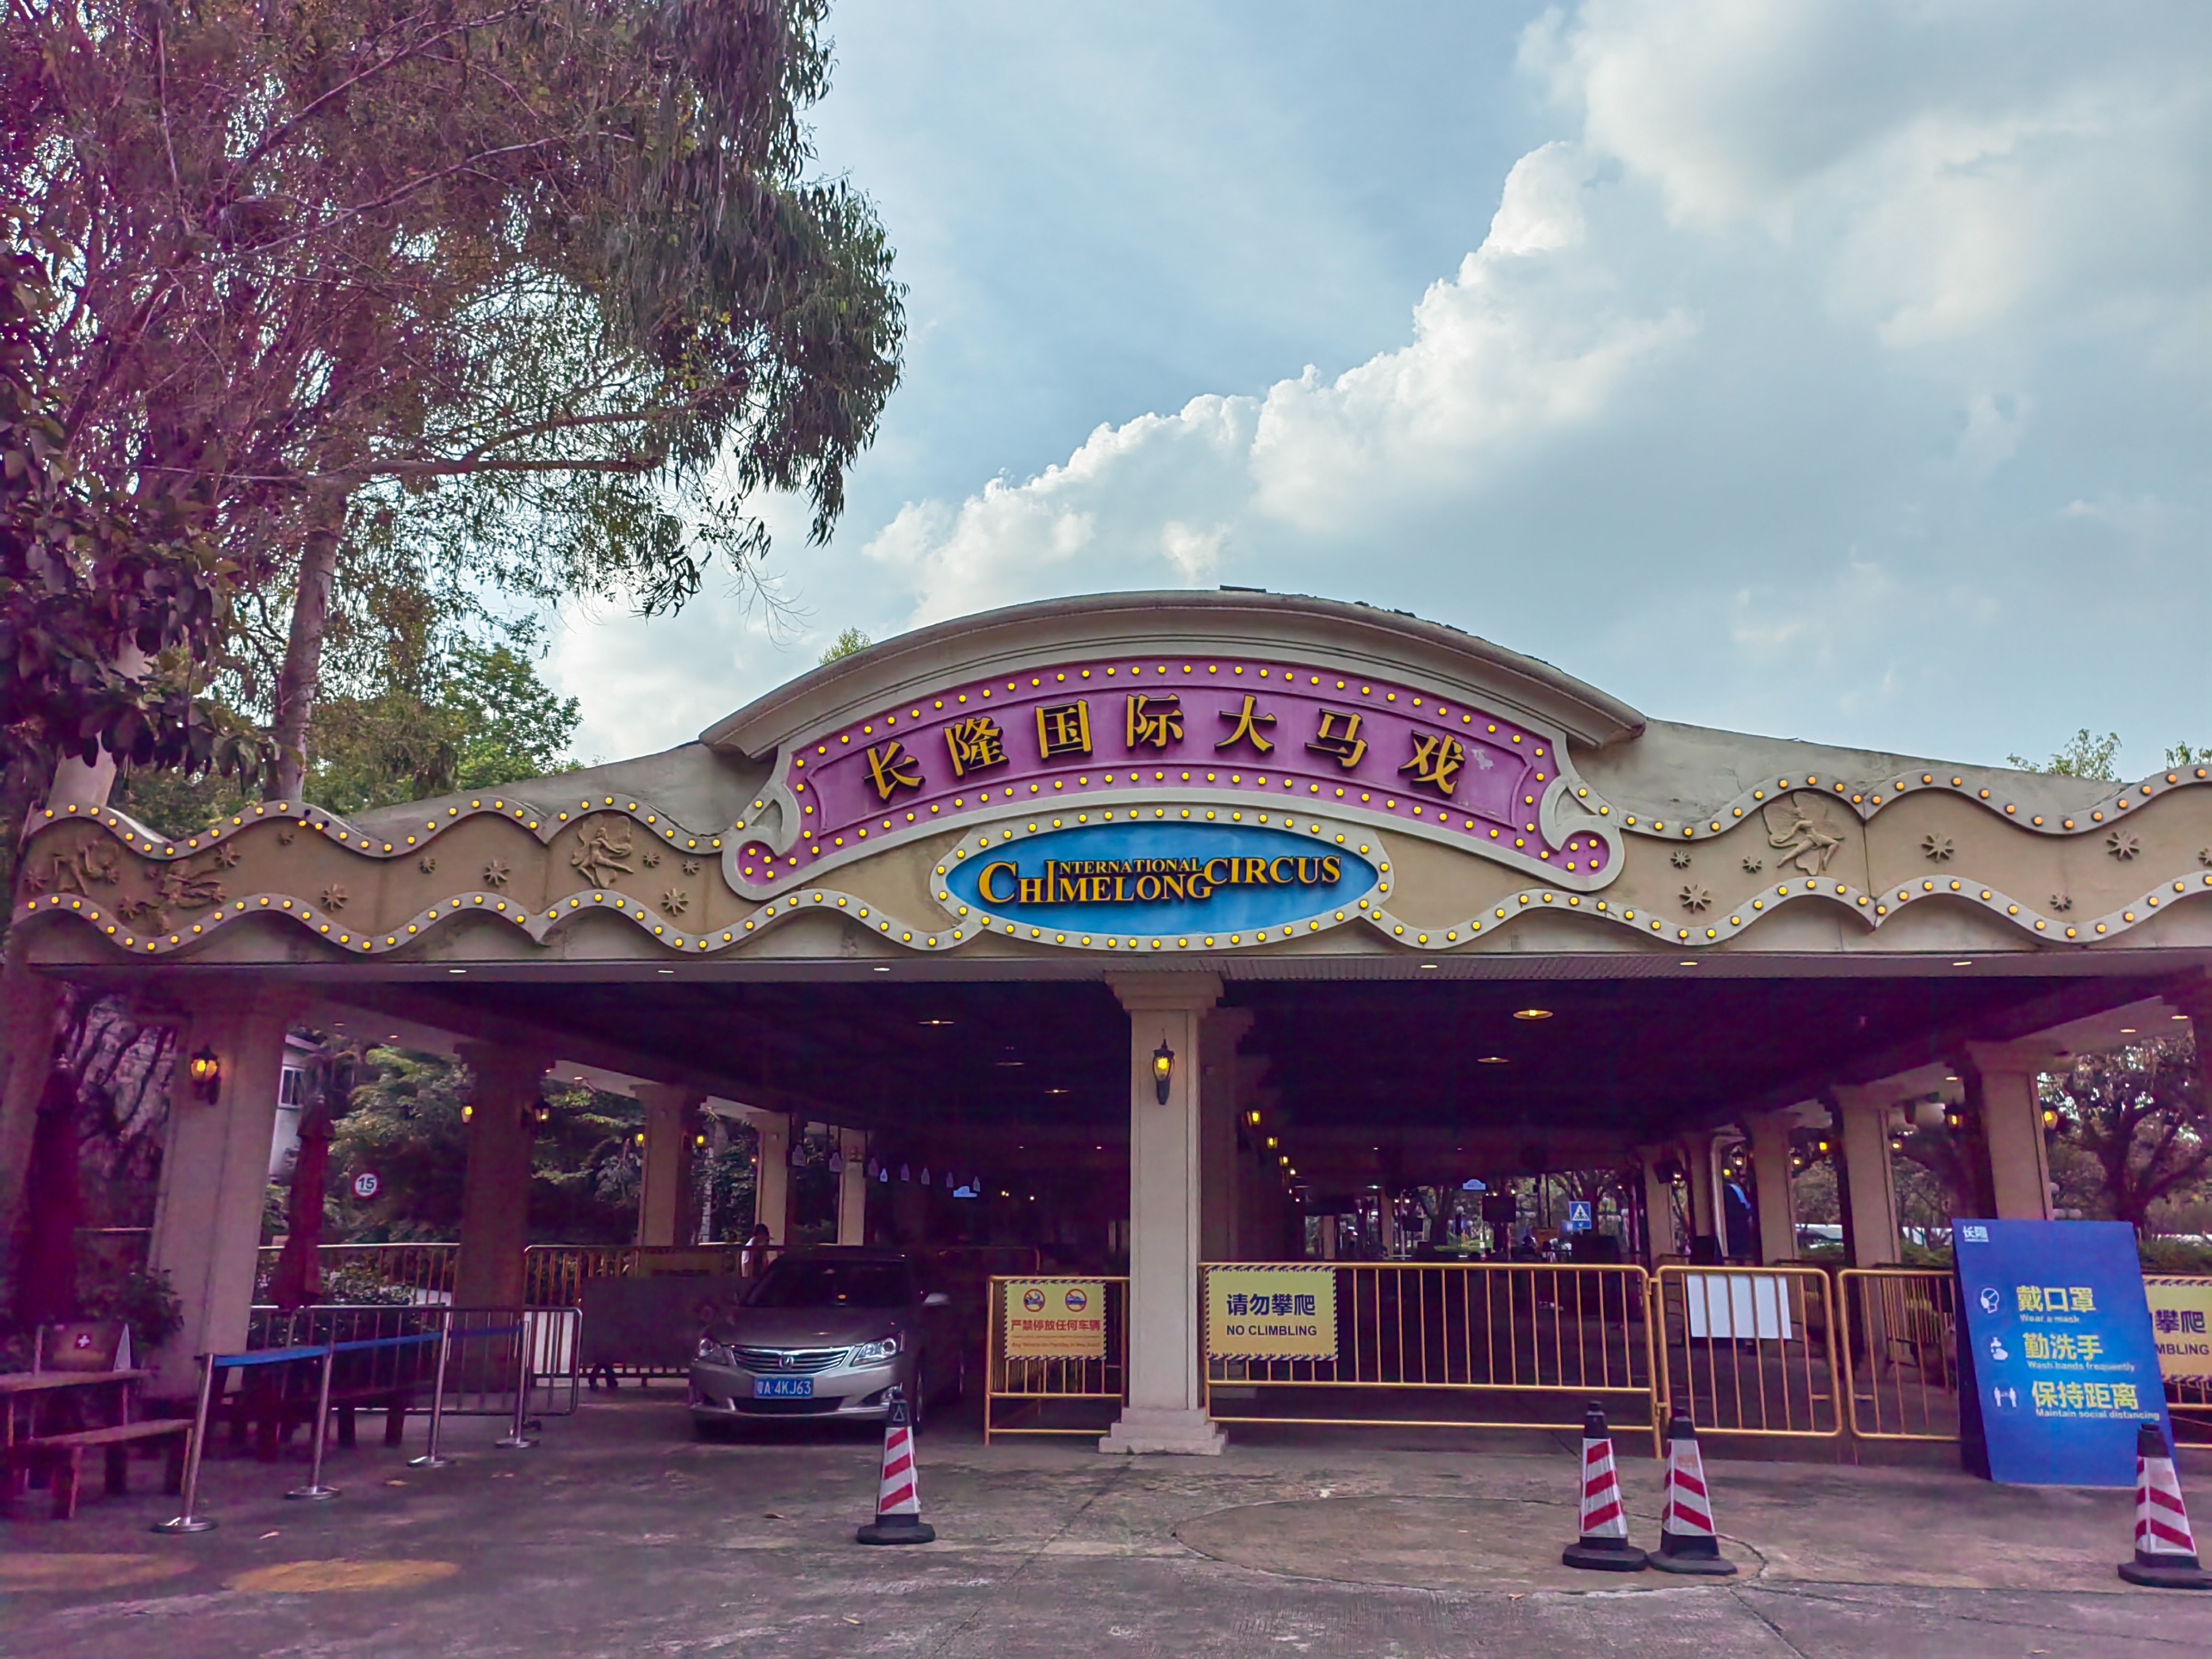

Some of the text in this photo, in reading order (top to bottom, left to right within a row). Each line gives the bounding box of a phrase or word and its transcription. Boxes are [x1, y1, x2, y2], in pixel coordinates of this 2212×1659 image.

[863, 693, 1465, 801] 长隆国际大马戏
[1203, 856, 1341, 885] CIRCUS
[359, 1177, 375, 1189] 15
[1226, 1293, 1316, 1316] 请勿攀爬
[2016, 1285, 2096, 1312] 戴口罩
[1011, 1319, 1100, 1331] 严禁停放任何车辆
[1226, 1325, 1317, 1336] NO CLIMBLING
[2054, 1315, 2079, 1323] mask
[2150, 1309, 2206, 1334] 攀爬
[2022, 1332, 2103, 1360] 勤洗手
[2027, 1361, 2135, 1372] Wash hands frequently
[2032, 1381, 2139, 1410] 保持距离
[2036, 1409, 2076, 1417] Maintain
[2109, 1411, 2160, 1421] distancing
